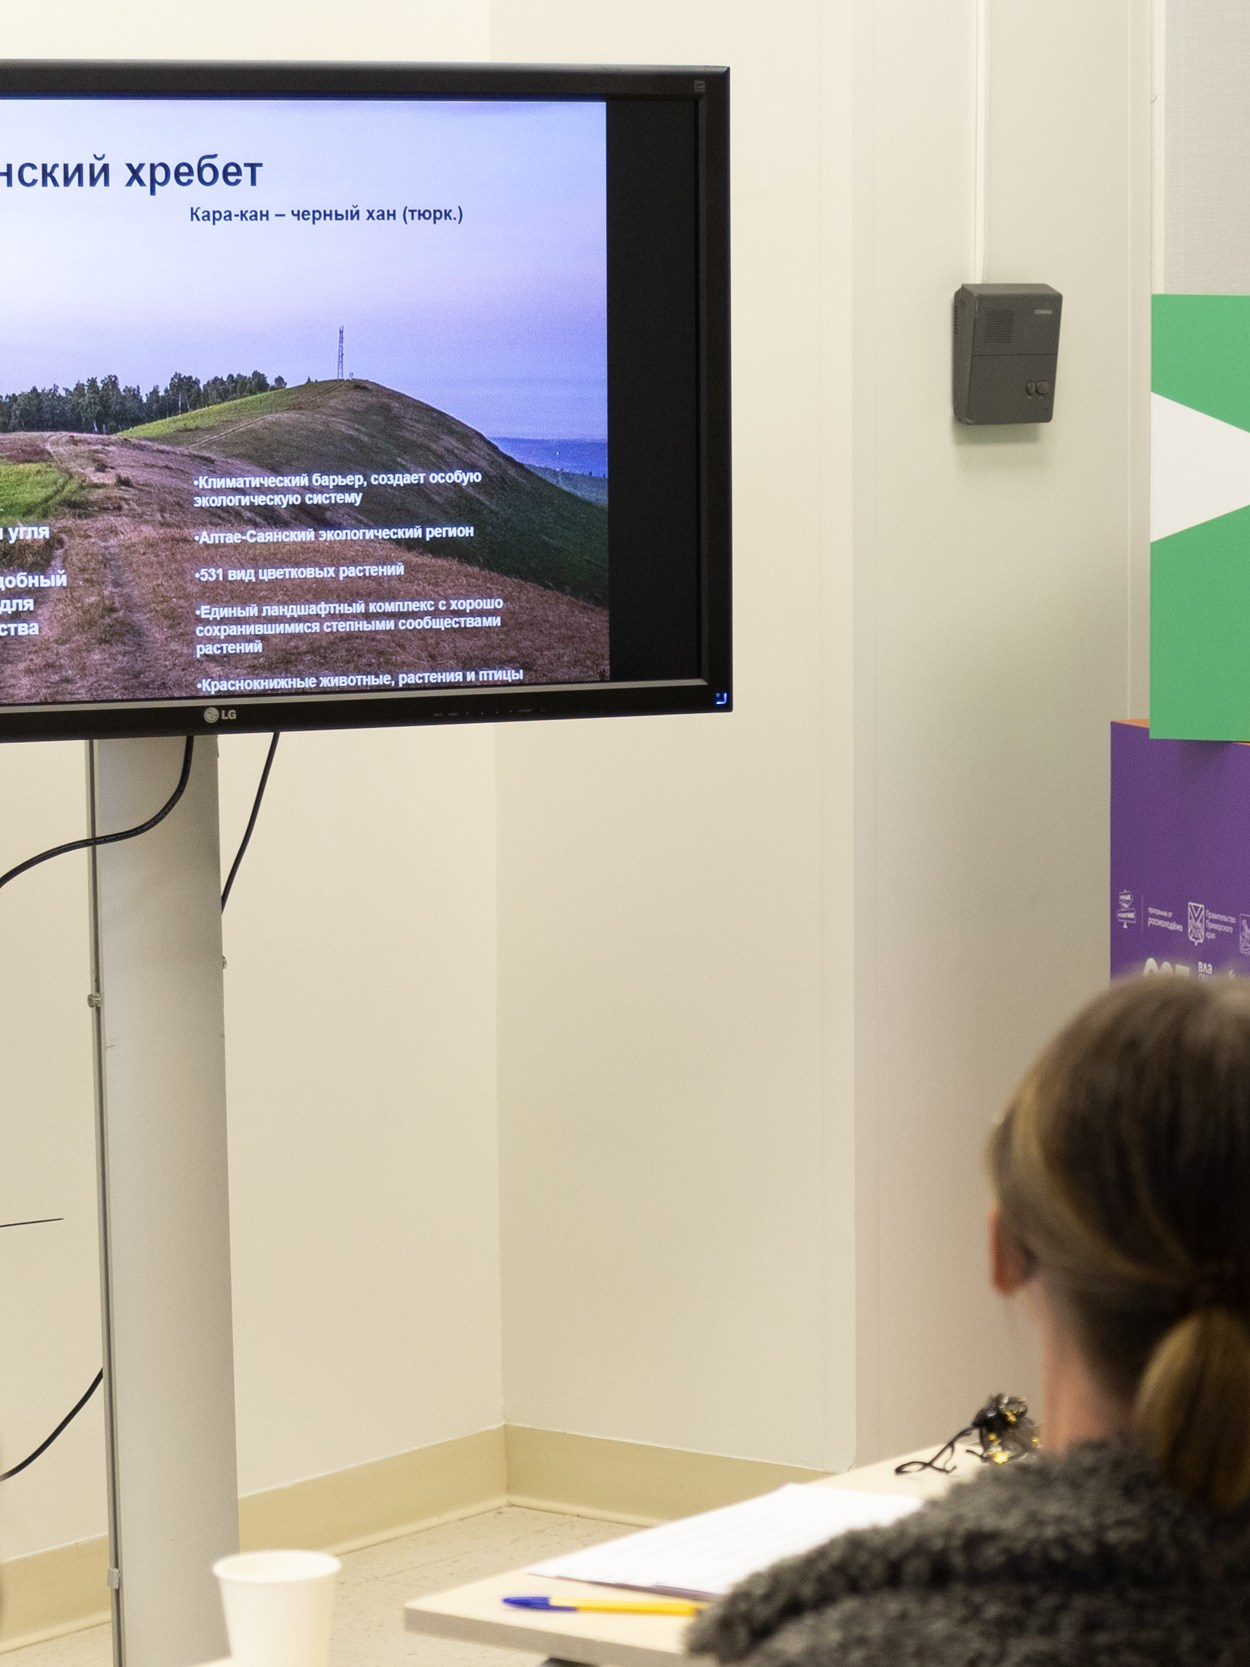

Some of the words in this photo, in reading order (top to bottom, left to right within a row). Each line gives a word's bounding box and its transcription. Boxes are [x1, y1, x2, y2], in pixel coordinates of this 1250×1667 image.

[125, 154, 263, 196] хребет
[189, 206, 270, 225] Кара-кан
[291, 205, 361, 225] черный
[366, 208, 397, 222] хан
[402, 206, 464, 225] (тюрк.)
[199, 472, 309, 489] Климатический
[312, 471, 368, 489] барьер,
[371, 472, 426, 487] создает
[429, 470, 483, 487] особую
[194, 493, 302, 508] экологическую
[305, 490, 363, 507] систему
[8, 526, 50, 544] угля
[199, 528, 315, 544] Алтае-Саянский
[318, 525, 423, 541] экологический
[426, 526, 475, 541] регион
[200, 567, 224, 581] 531
[228, 567, 256, 582] вид
[259, 566, 336, 582] цветковых
[339, 562, 405, 580] растений
[0, 598, 35, 614] для
[200, 603, 258, 621] Единый
[262, 600, 365, 618] ландшафтный
[369, 598, 435, 614] комплекс
[438, 600, 447, 611] с
[450, 597, 504, 613] хорошо
[196, 620, 320, 640] сохранившимися
[323, 617, 395, 634] степными
[398, 614, 502, 633] сообществами
[196, 638, 263, 658] растений
[202, 675, 317, 695] Краснокнижные
[319, 671, 395, 691] животные,
[398, 669, 463, 687] растения
[466, 669, 476, 682] и
[478, 666, 524, 684] птицы
[221, 709, 237, 720] LG
